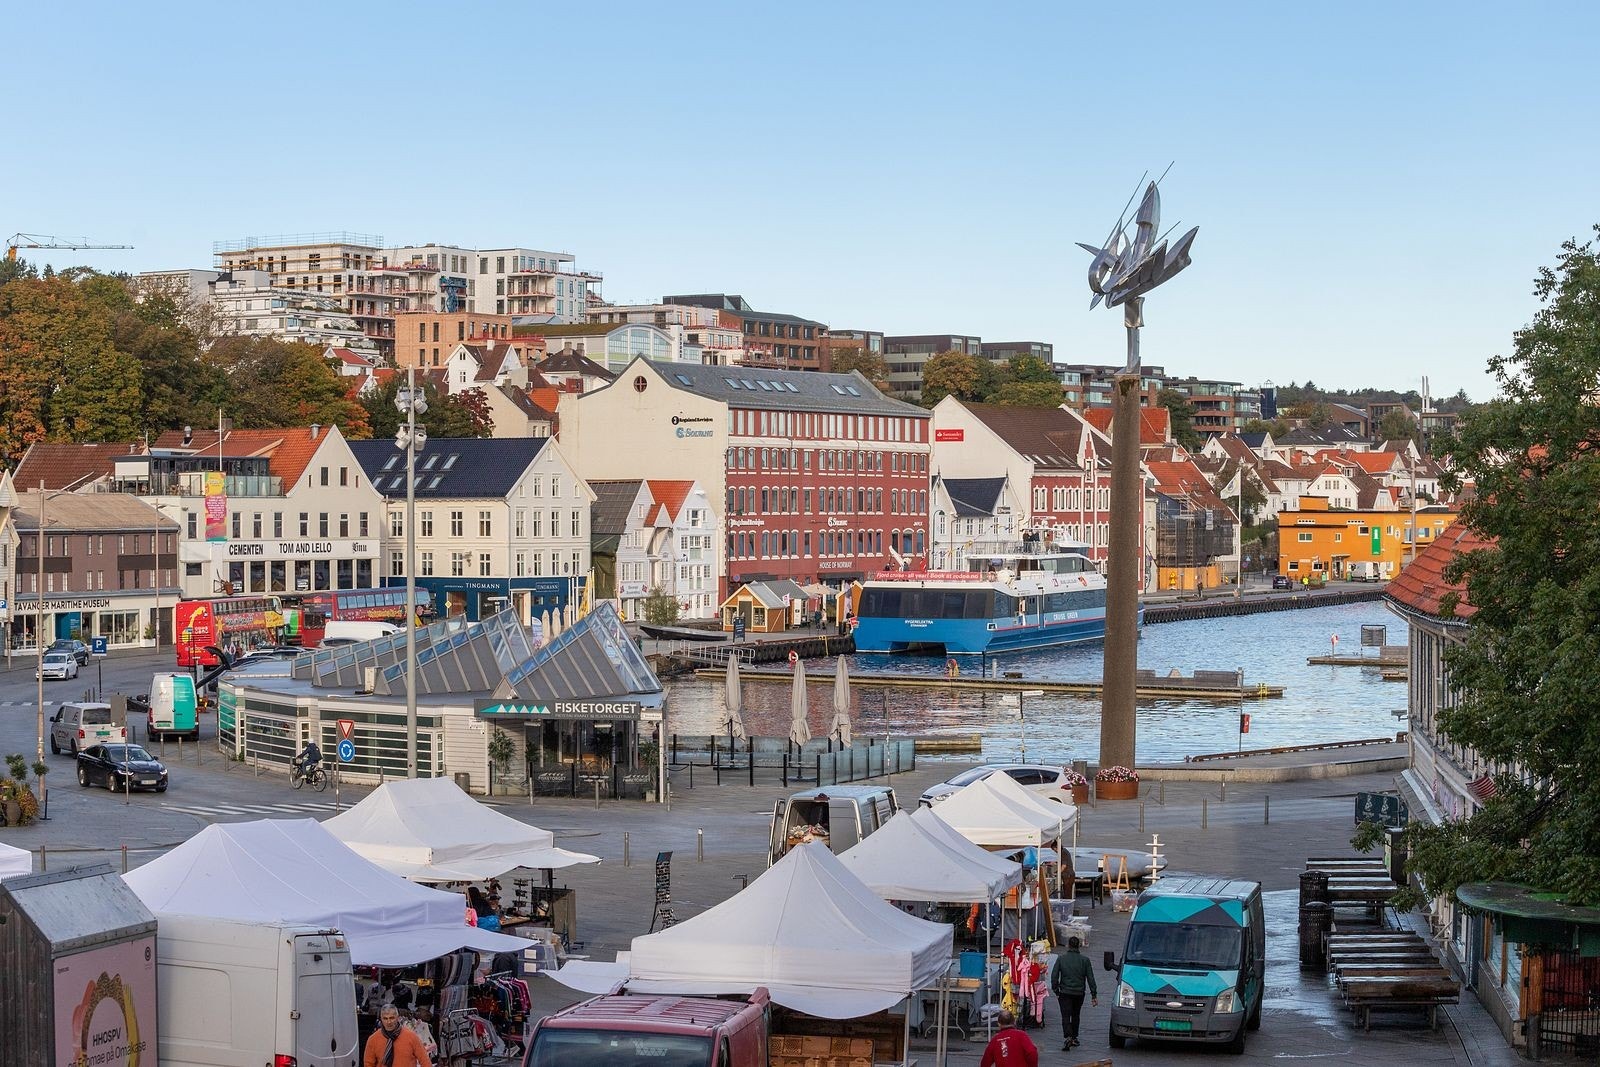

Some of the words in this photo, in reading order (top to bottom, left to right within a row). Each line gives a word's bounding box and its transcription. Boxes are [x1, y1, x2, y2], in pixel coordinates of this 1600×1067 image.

[229, 544, 264, 555] CEMENTEN
[279, 543, 294, 554] TOM
[295, 543, 310, 553] AND
[311, 542, 332, 553] LELLO
[50, 600, 82, 610] MARITIME
[83, 599, 110, 609] MUSEUM
[96, 640, 103, 649] P
[554, 702, 637, 714] FISKETORGET
[106, 1044, 115, 1064] på
[115, 1041, 147, 1059] Omakase
